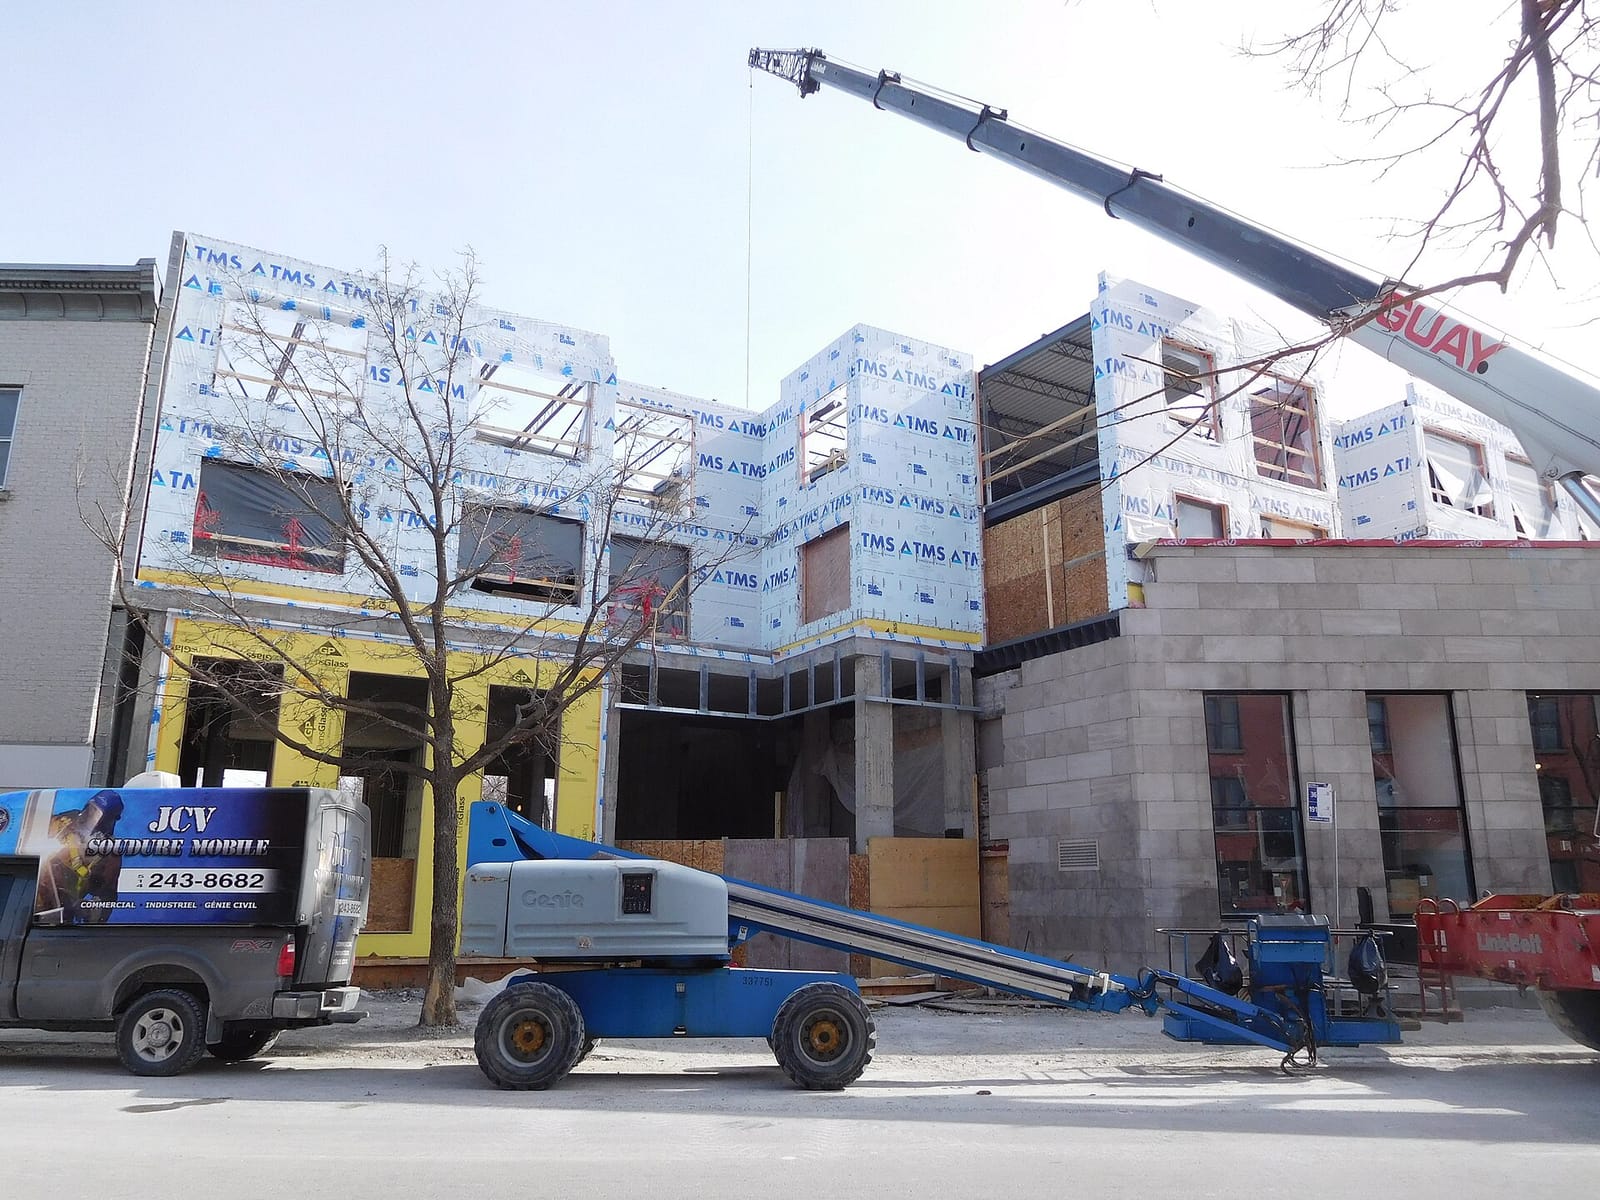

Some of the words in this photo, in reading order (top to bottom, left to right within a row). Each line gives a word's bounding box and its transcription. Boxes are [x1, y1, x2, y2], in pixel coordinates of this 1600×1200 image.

[1375, 291, 1510, 374] GUAY
[148, 806, 217, 834] JCV
[86, 837, 185, 858] SOUDURE
[191, 839, 271, 858] MOBILE
[149, 872, 266, 889] 243-8682
[80, 901, 136, 910] COMMERCIAL
[145, 901, 197, 910] INDUSTRIEL
[205, 899, 231, 910] GÉNIE
[233, 901, 257, 910] CIVIL
[521, 890, 584, 909] Genie
[741, 976, 773, 986] 337751
